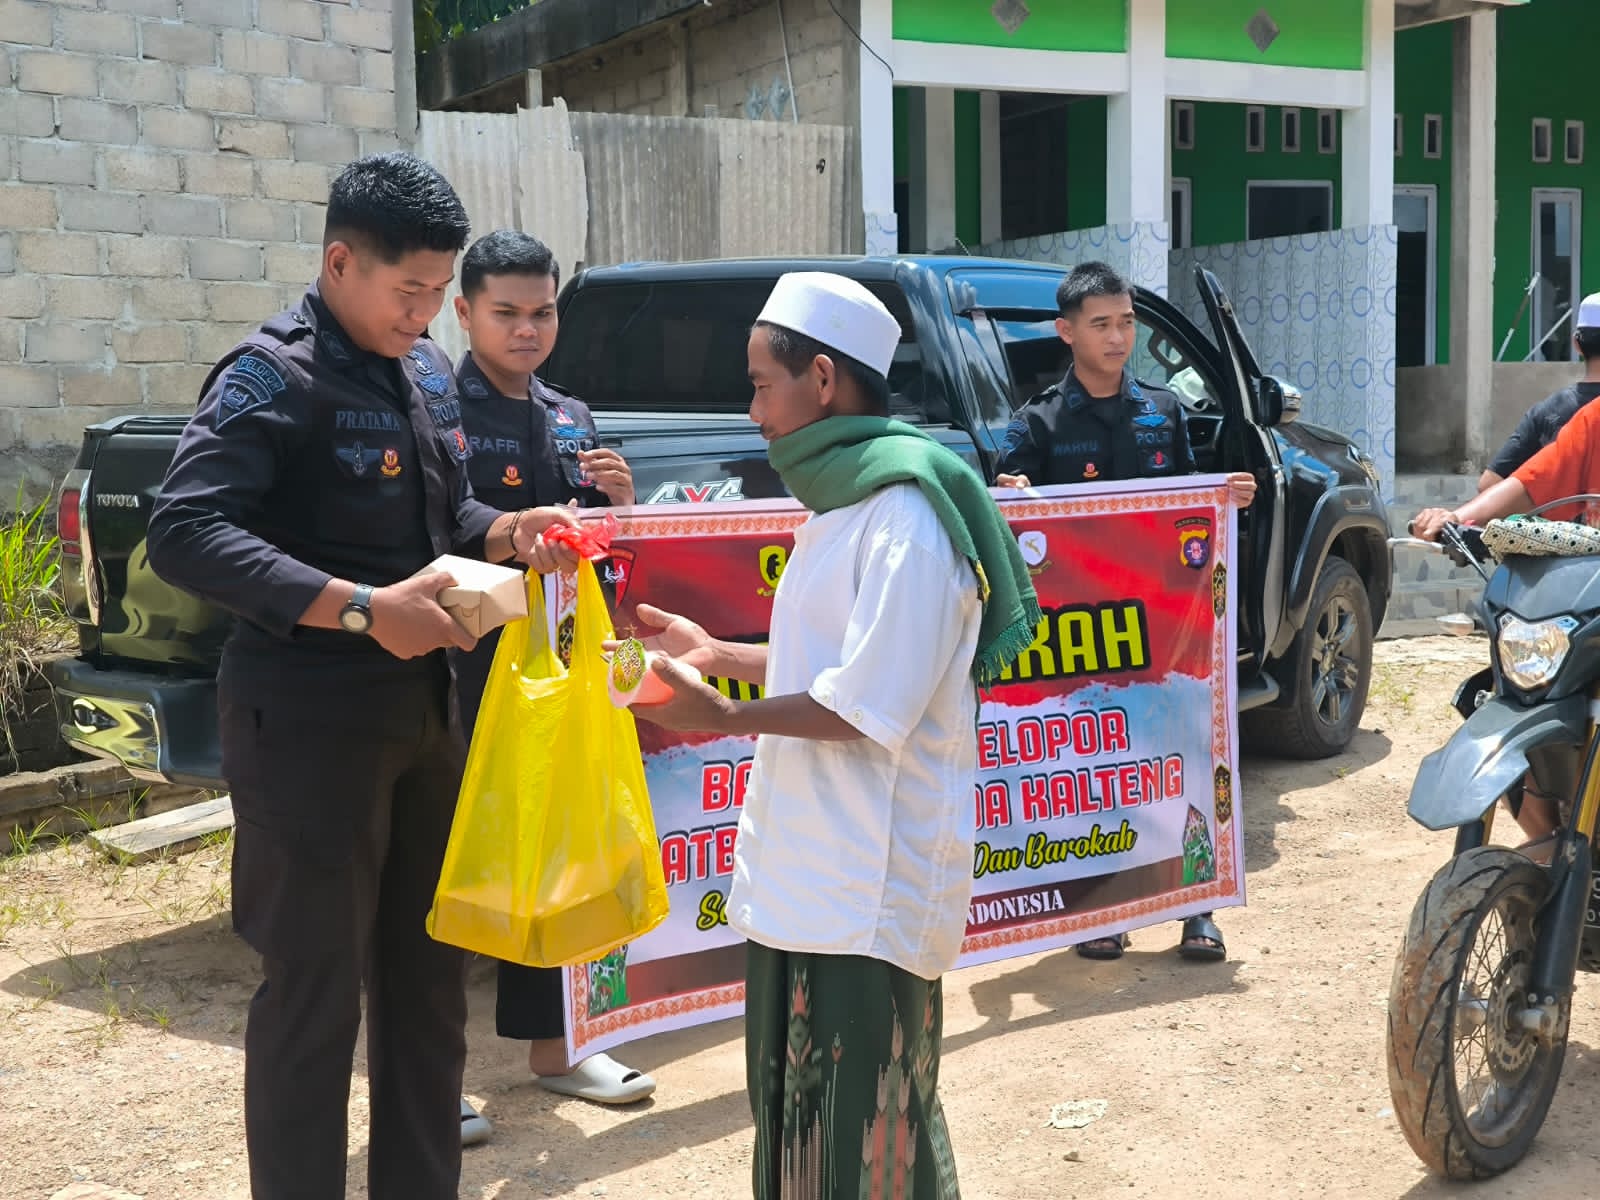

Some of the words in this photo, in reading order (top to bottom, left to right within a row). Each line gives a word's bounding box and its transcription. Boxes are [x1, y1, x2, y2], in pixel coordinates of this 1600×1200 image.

[240, 358, 282, 391] PELOPOR
[335, 410, 400, 431] PRATAMA
[470, 436, 521, 454] RAFFI
[96, 494, 139, 508] TOYOTA
[1000, 606, 1145, 680] KAH
[702, 756, 755, 813] BA
[977, 707, 1128, 769] ELOPOR
[1021, 753, 1184, 824] KALTENG
[1025, 820, 1137, 868] Barokah
[966, 889, 1065, 926] NDONESIA
